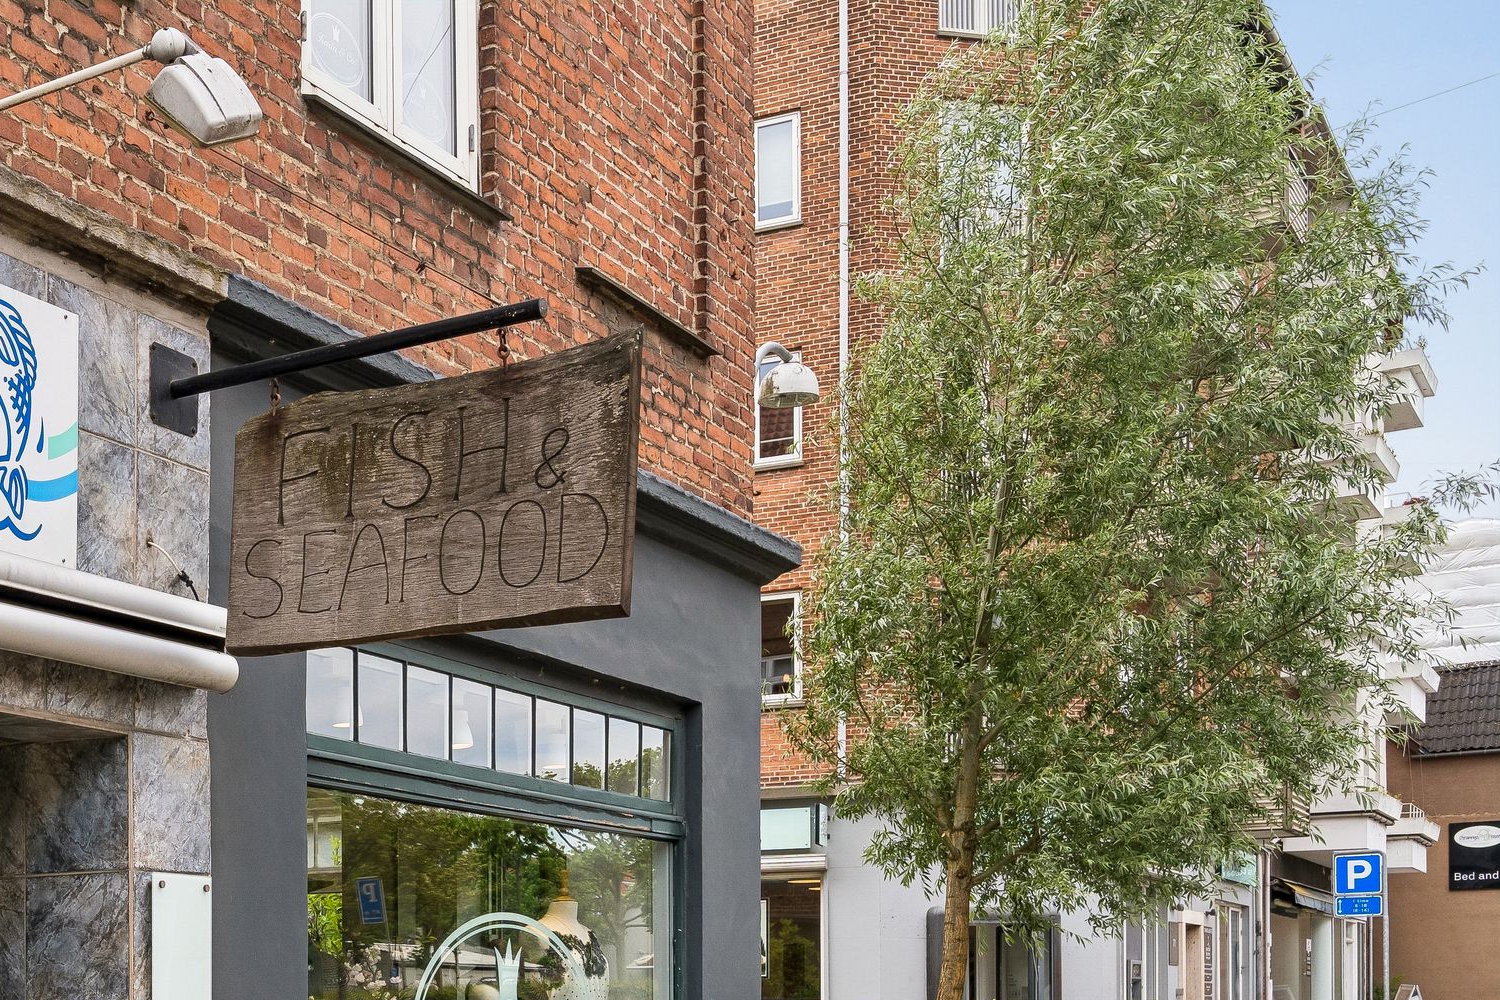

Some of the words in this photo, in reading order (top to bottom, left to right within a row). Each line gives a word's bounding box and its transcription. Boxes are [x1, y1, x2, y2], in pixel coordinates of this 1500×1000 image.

[277, 398, 510, 526] FISH
[534, 427, 569, 489] &
[243, 493, 609, 619] SEAFOOD
[1347, 860, 1372, 889] P
[1454, 871, 1475, 881] Bed
[1478, 870, 1499, 880] and
